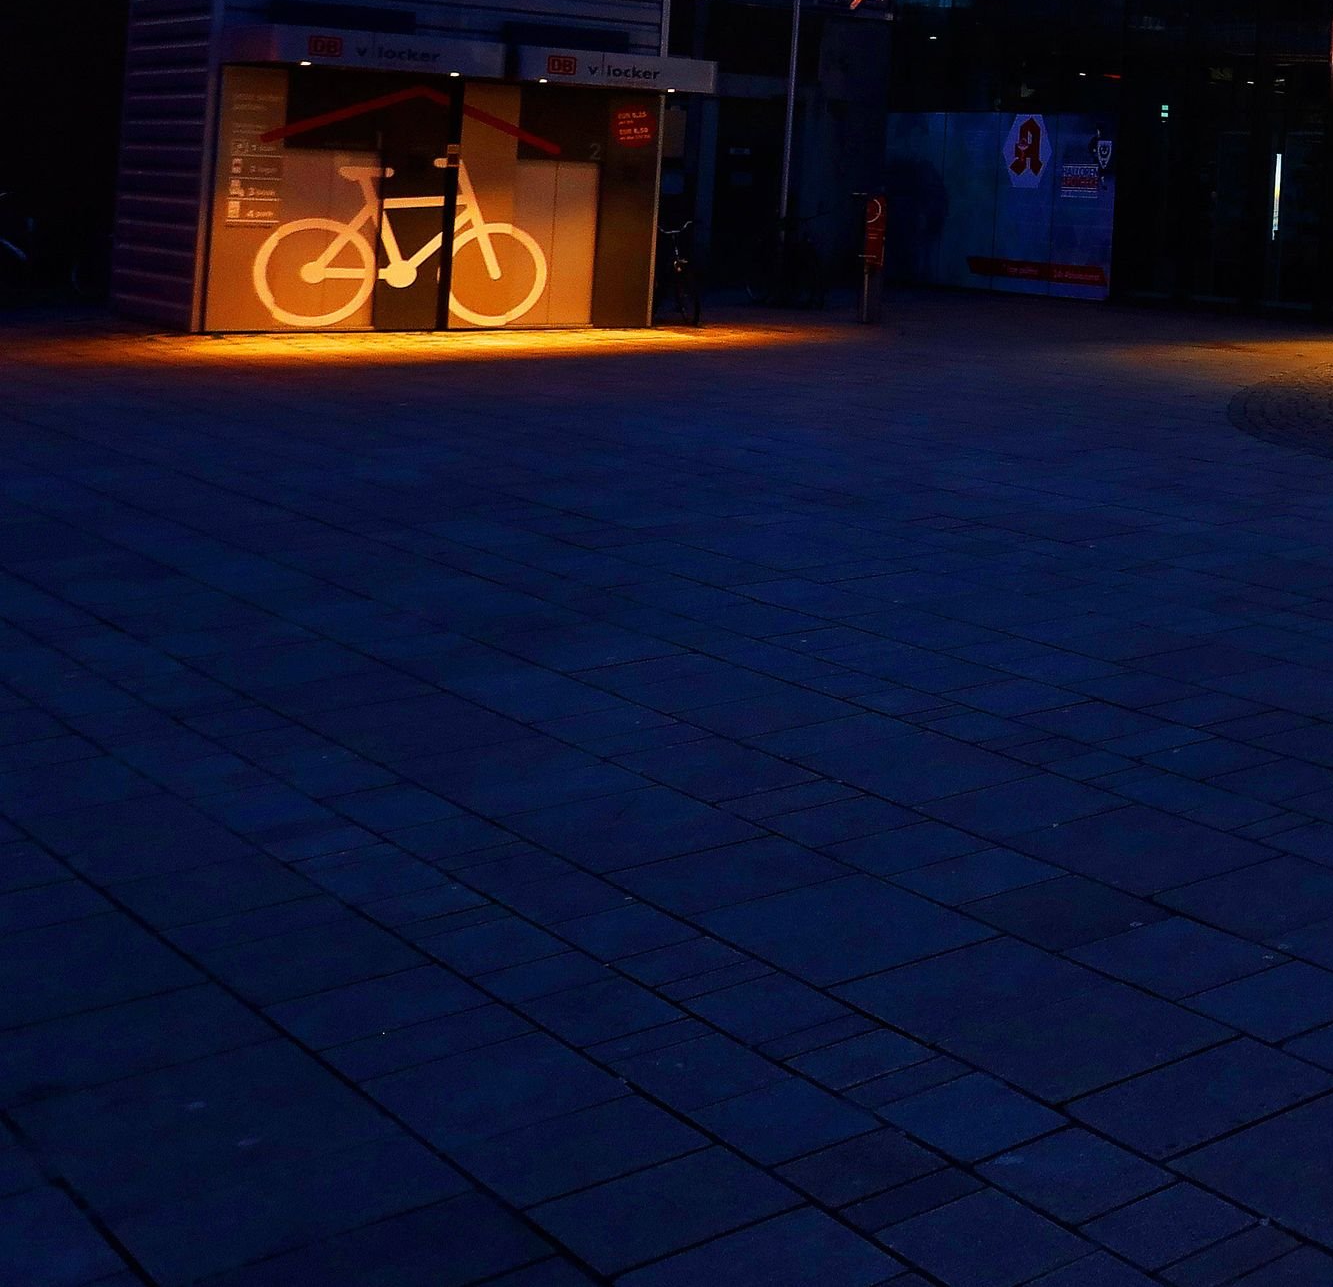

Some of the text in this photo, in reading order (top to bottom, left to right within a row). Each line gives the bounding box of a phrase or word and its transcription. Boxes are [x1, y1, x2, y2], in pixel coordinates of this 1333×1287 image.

[313, 38, 340, 55] DB
[378, 46, 441, 62] locker
[551, 59, 574, 73] DB
[607, 64, 660, 81] locker
